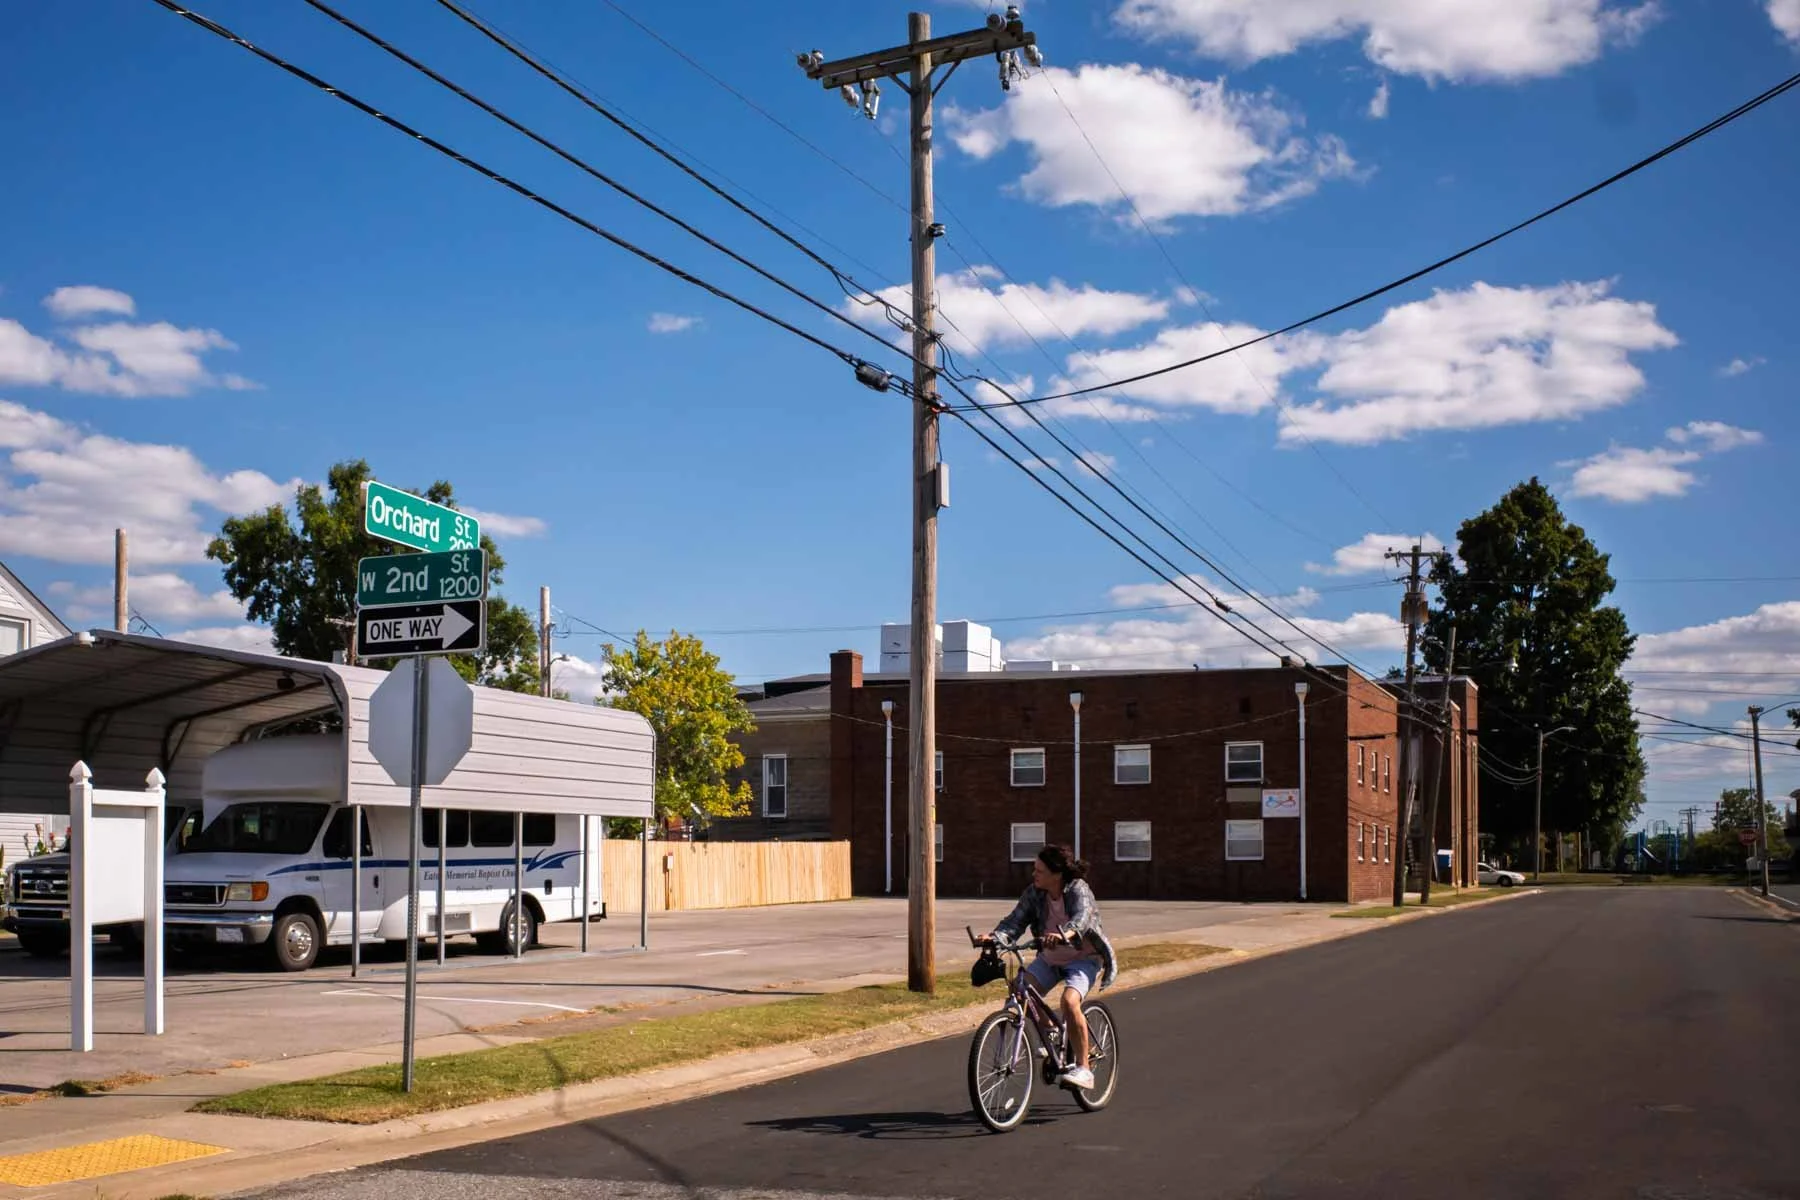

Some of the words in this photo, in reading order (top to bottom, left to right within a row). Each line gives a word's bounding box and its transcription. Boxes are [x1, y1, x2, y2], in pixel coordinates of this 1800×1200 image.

[371, 495, 440, 543] Orchard
[362, 571, 377, 592] W
[386, 564, 429, 594] 2nd
[440, 575, 480, 598] 1200
[370, 621, 403, 640] ONE
[409, 617, 443, 638] WAY
